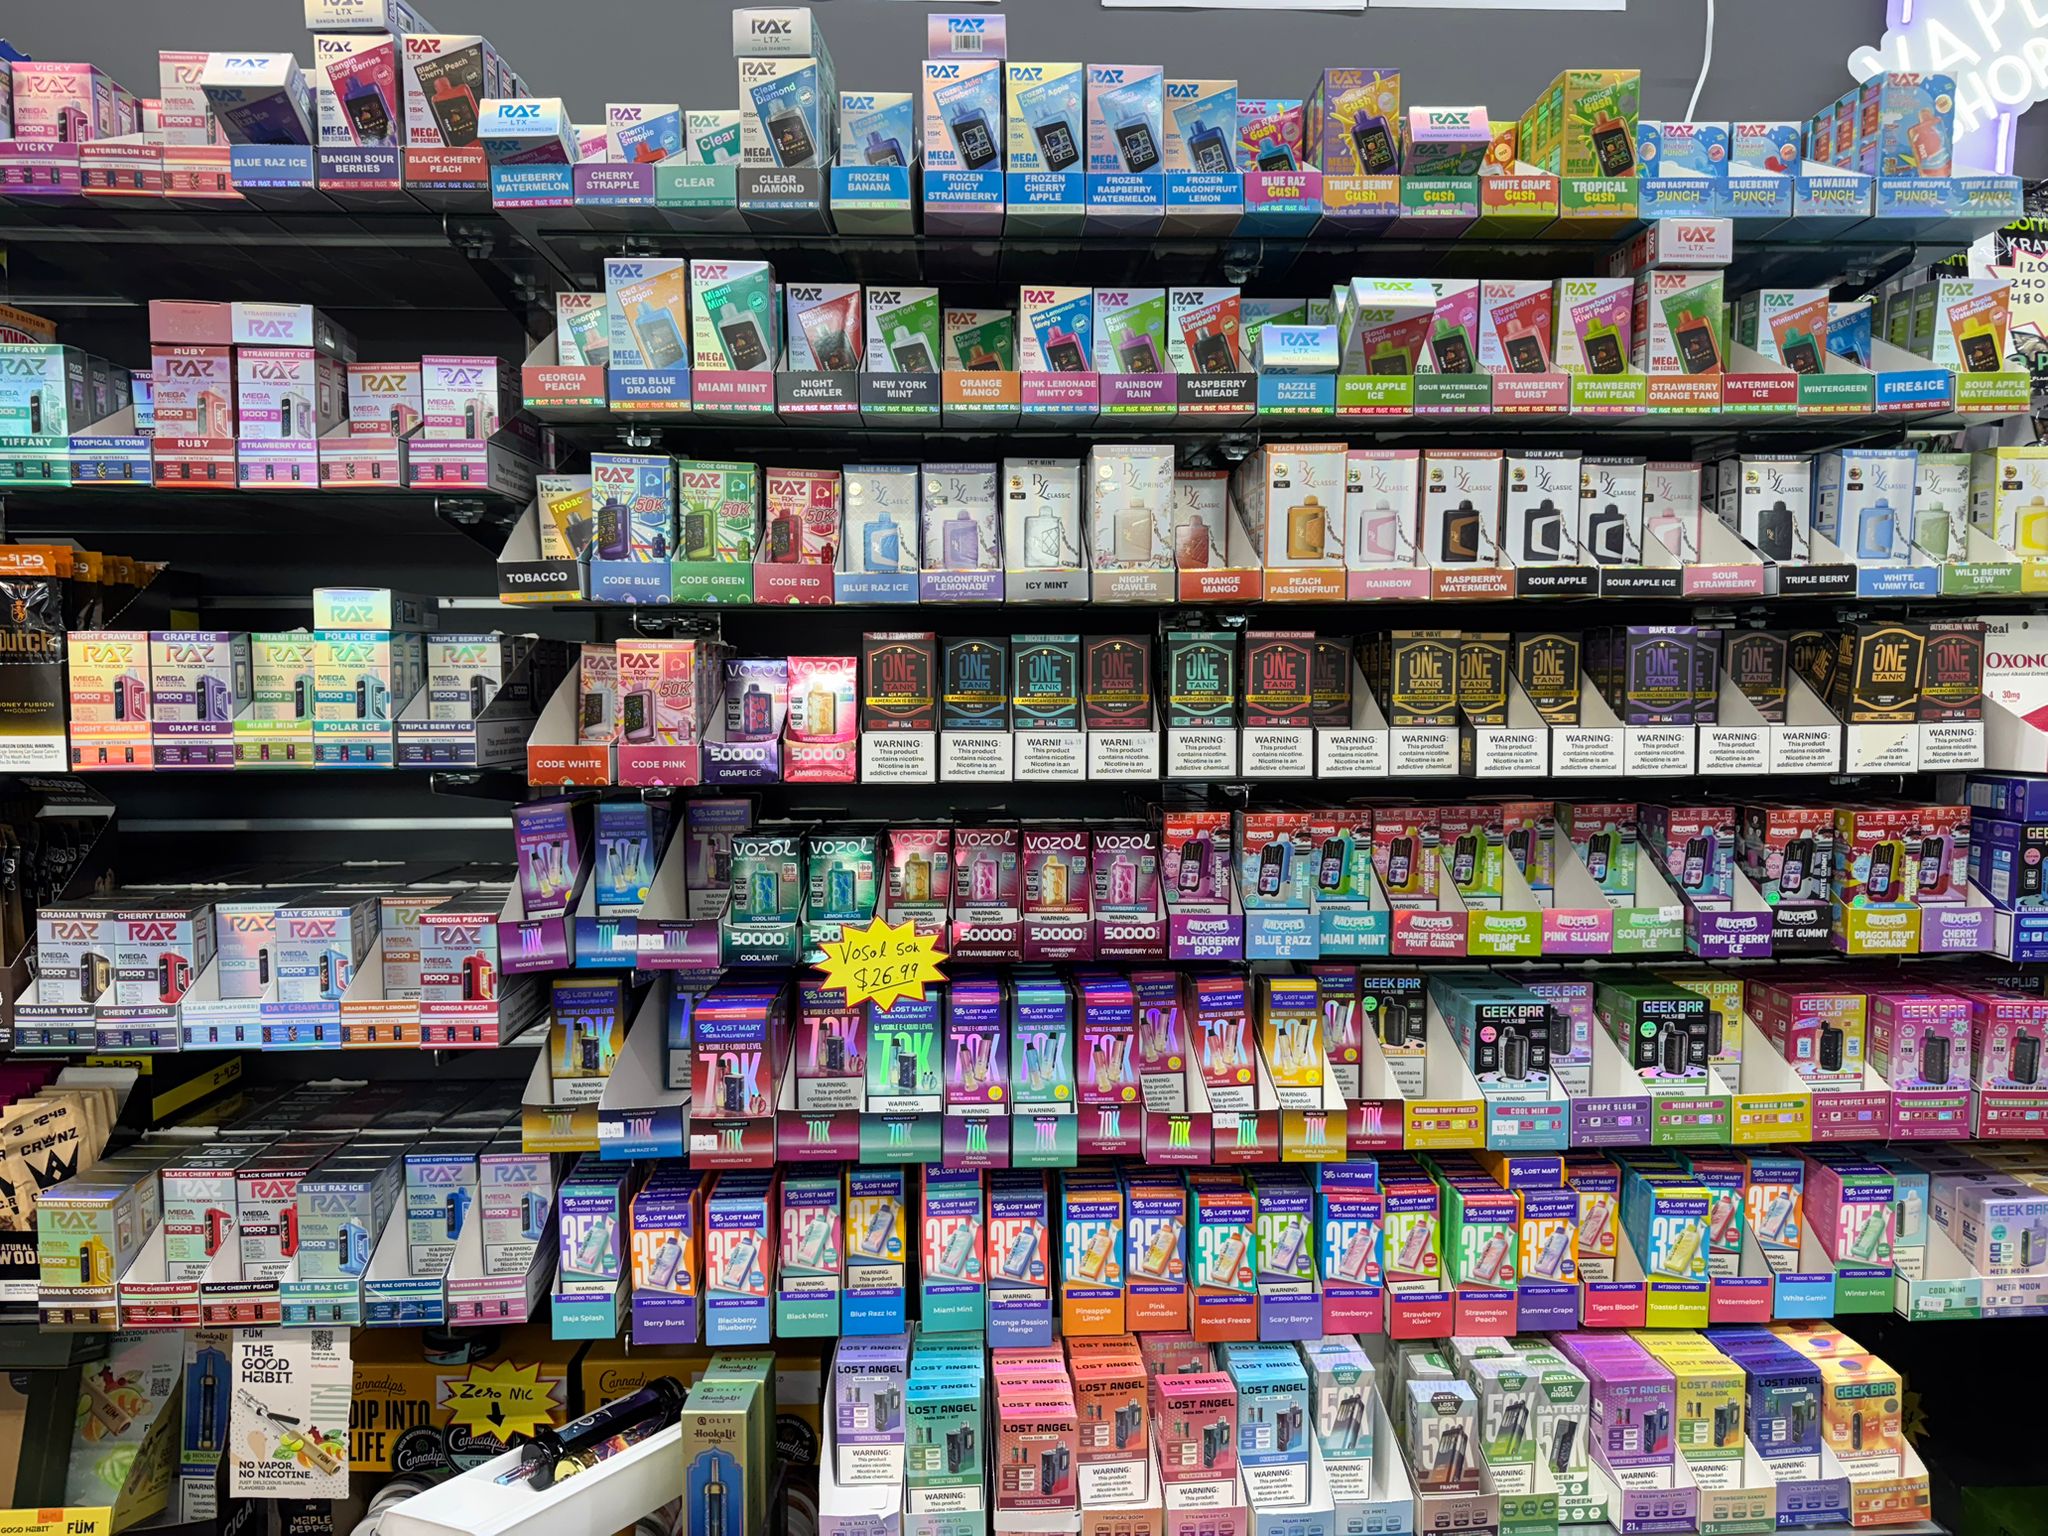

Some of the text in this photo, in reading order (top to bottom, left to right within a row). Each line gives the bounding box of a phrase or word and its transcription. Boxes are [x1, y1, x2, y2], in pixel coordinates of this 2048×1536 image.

[751, 19, 791, 34] RAZ
[948, 19, 984, 32] RAZ
[16, 143, 53, 151] VICKY
[234, 158, 307, 167] BLUE RAZ ICE
[321, 154, 394, 164] BANGIN SOUR
[336, 164, 380, 173] BERRIES
[500, 173, 563, 183] BLUEBERRY
[759, 175, 796, 184] CLEAR
[943, 174, 983, 183] FROZEN
[1810, 177, 1858, 188] HAWAIIAN
[496, 182, 569, 192] WATERMELON
[752, 184, 804, 193] DIAMOND
[948, 183, 979, 192] JUICY
[1490, 179, 1551, 191] WHITE GRAPE
[928, 192, 998, 201] STRAWBERRY
[1811, 189, 1855, 201] PUNCH
[609, 264, 643, 278] RAZ
[2011, 279, 2046, 288] 240
[2011, 293, 2044, 304] 480
[538, 373, 586, 382] GEORGIA
[621, 377, 675, 385] ICED BLUE
[545, 382, 580, 391] PEACH
[698, 383, 767, 393] MIAMI MINT
[872, 380, 927, 389] NEW YORK
[1187, 379, 1246, 389] RASPBERRY
[1345, 382, 1406, 391] SOUR APPLE
[1885, 380, 1944, 393] FIRE&ICE
[627, 385, 671, 395] DRAGON
[887, 389, 912, 398] MINT
[1195, 388, 1238, 398] LIMEADE
[1368, 391, 1384, 400] ICE
[72, 438, 145, 448] TROPICAL STORM
[177, 439, 209, 449] RUBY
[241, 441, 312, 451] STRAWBERRY ICE
[634, 497, 665, 513] 50K
[507, 571, 567, 583] TOBACCO
[603, 576, 660, 586] CODE BLUE
[680, 576, 745, 585] CODE GREEN
[927, 575, 995, 584] DRAGONFRUIT
[1289, 577, 1321, 586] PEACH
[1786, 575, 1849, 584] TRIPLE BERRY
[1884, 574, 1914, 582] WHITE
[935, 582, 988, 591] LEMONADE
[1025, 581, 1068, 590] ICY MINT
[1366, 579, 1411, 588] RAINBOW
[1872, 582, 1925, 590] YUMMY ICE
[1270, 585, 1340, 594] PASSIONFRUIT
[1986, 623, 2008, 633] Real
[959, 654, 991, 680] ONE
[2002, 690, 2020, 699] 30mg
[169, 723, 216, 733] GRAPE ICE
[324, 722, 380, 732] POLAR ICE
[711, 748, 766, 761] 50000
[537, 760, 601, 768] CODE WHITE
[720, 769, 761, 777] GRAPE ICE
[732, 932, 784, 946] 50000
[1255, 937, 1311, 946] BLUE RAZZ
[1544, 932, 1609, 944] PINK SLUSHY
[1276, 946, 1290, 955] ICE
[741, 954, 761, 962] COOL
[19, 1006, 89, 1015] GRAHAM TWIST
[1643, 1001, 1704, 1013] GEEK BAR
[103, 1007, 168, 1017] CHERRY LEMON
[1482, 1006, 1544, 1018] GEEK BAR
[739, 1024, 761, 1032] MARY
[725, 1042, 747, 1050] E-LIQUID
[807, 1121, 830, 1143] 70K
[38, 1286, 112, 1296] BANANA COCONUT
[290, 1283, 349, 1292] BLUE RAZ ICE
[1521, 1307, 1573, 1315] Summer Grape
[580, 1314, 604, 1322] Splash
[644, 1319, 685, 1328] Berry Burst
[242, 1358, 289, 1370] GOOD
[460, 1383, 534, 1401] Zero NIC
[1836, 1383, 1895, 1398] GEEK BAR
[385, 1400, 430, 1429] INTO
[1003, 1423, 1074, 1433] LOST ANGEL
[351, 1433, 386, 1461] LIFE
[239, 1461, 294, 1469] NO VAPOR.
[262, 1471, 313, 1479] NICOTINE.
